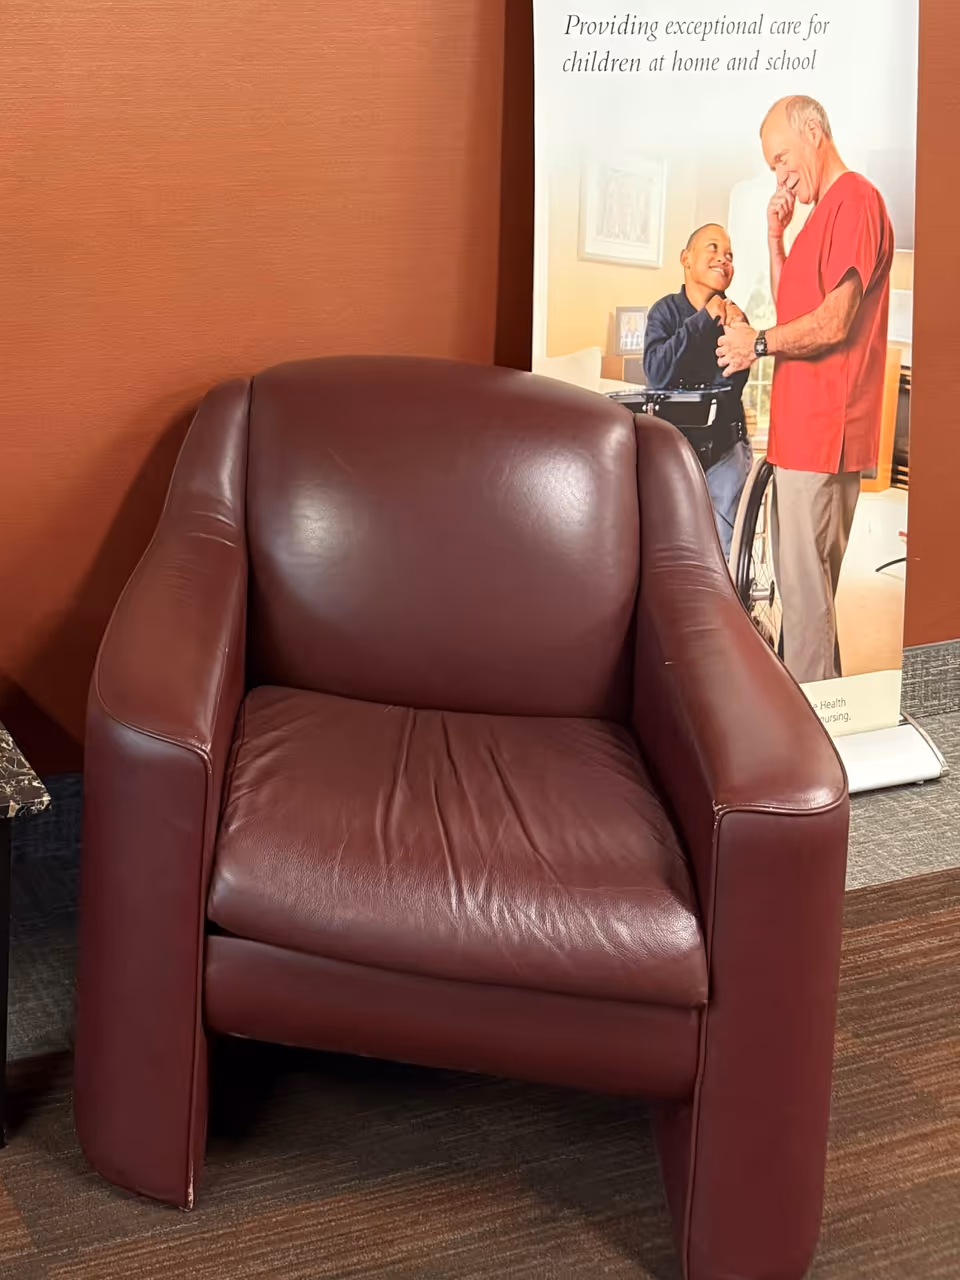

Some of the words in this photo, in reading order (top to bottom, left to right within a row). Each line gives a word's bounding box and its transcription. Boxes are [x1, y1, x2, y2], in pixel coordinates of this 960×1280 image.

[565, 14, 658, 41] Providing
[666, 14, 763, 41] exceptional
[770, 21, 801, 34] care
[803, 14, 831, 41] for
[563, 51, 640, 72] children
[649, 55, 664, 71] at
[672, 50, 719, 71] home
[727, 50, 759, 70] and
[766, 50, 816, 70] school
[820, 697, 847, 710] Health
